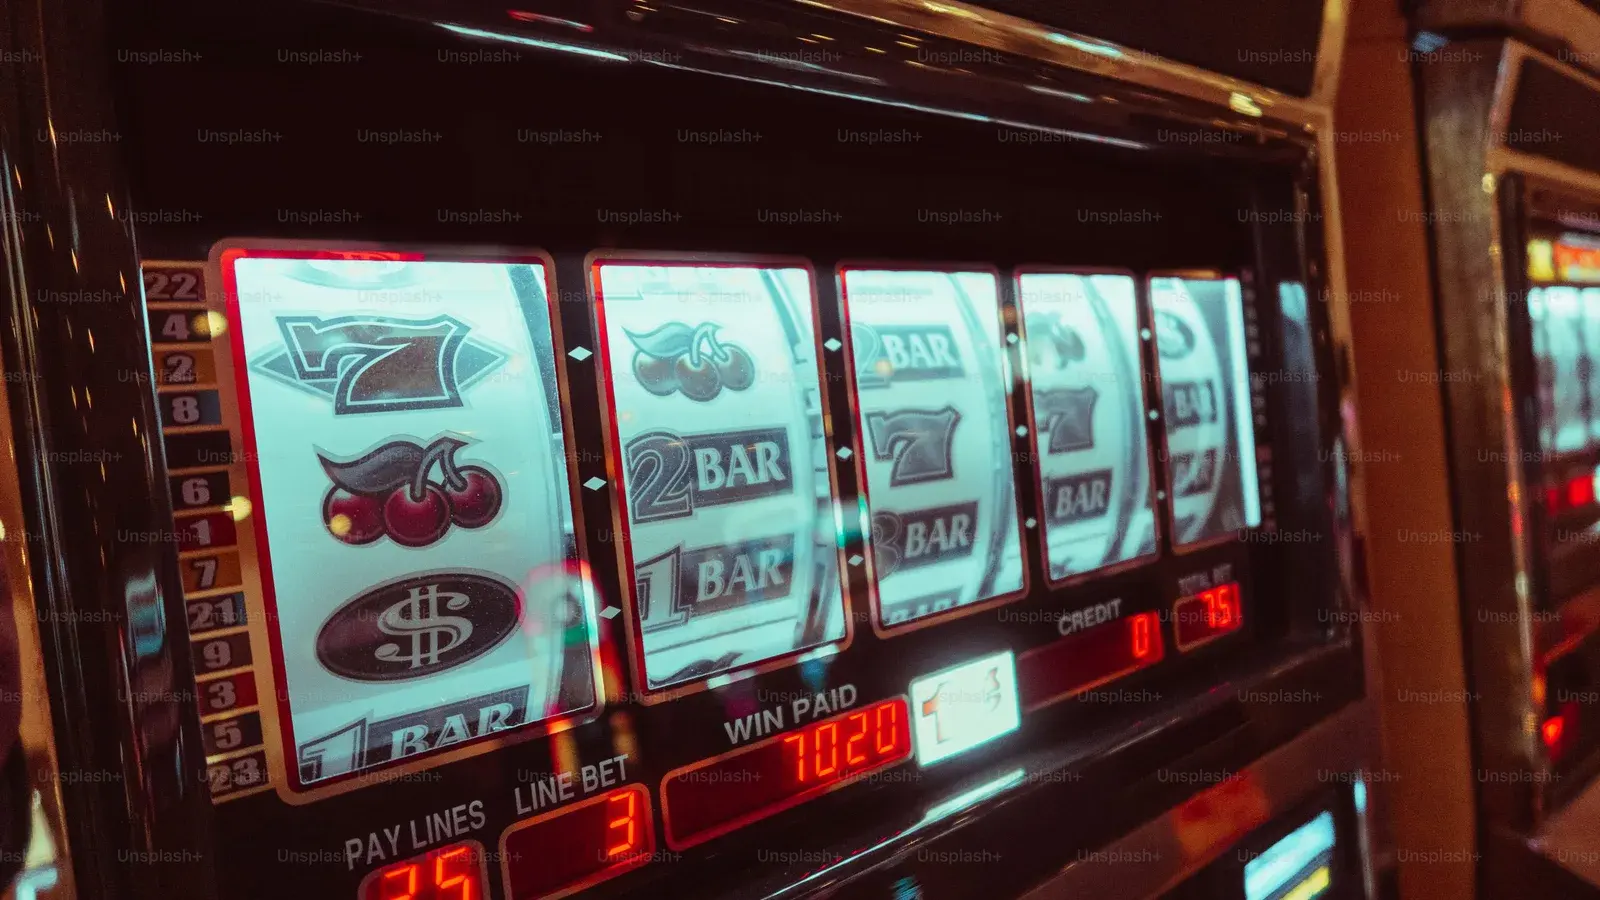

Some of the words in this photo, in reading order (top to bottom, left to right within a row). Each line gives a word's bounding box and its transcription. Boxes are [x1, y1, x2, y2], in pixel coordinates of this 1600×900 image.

[145, 272, 197, 299] 22
[162, 313, 190, 340] 4
[165, 355, 193, 383] 2
[881, 333, 957, 369] BAR
[172, 396, 199, 423] 8
[181, 478, 210, 505] 6
[624, 431, 693, 525] 2
[695, 440, 787, 492] BAR
[1054, 479, 1106, 518] BAR
[190, 519, 211, 546] 1
[904, 513, 971, 559] BAR
[192, 558, 217, 588] 7
[697, 548, 785, 602] BAR
[187, 598, 236, 630] 21
[1058, 598, 1122, 636] CREDIT
[1203, 588, 1231, 629] 75
[203, 640, 231, 668] 9
[1133, 614, 1149, 658] 0
[209, 680, 236, 709] 3
[724, 705, 785, 745] WIN
[792, 684, 858, 724] PAID
[214, 720, 242, 750] 5
[783, 702, 897, 782] 7020
[209, 757, 260, 793] 23
[514, 771, 575, 815] LINE
[581, 753, 630, 793] BET
[345, 824, 402, 870] PAY
[410, 800, 486, 849] LINES
[608, 790, 635, 857] 3
